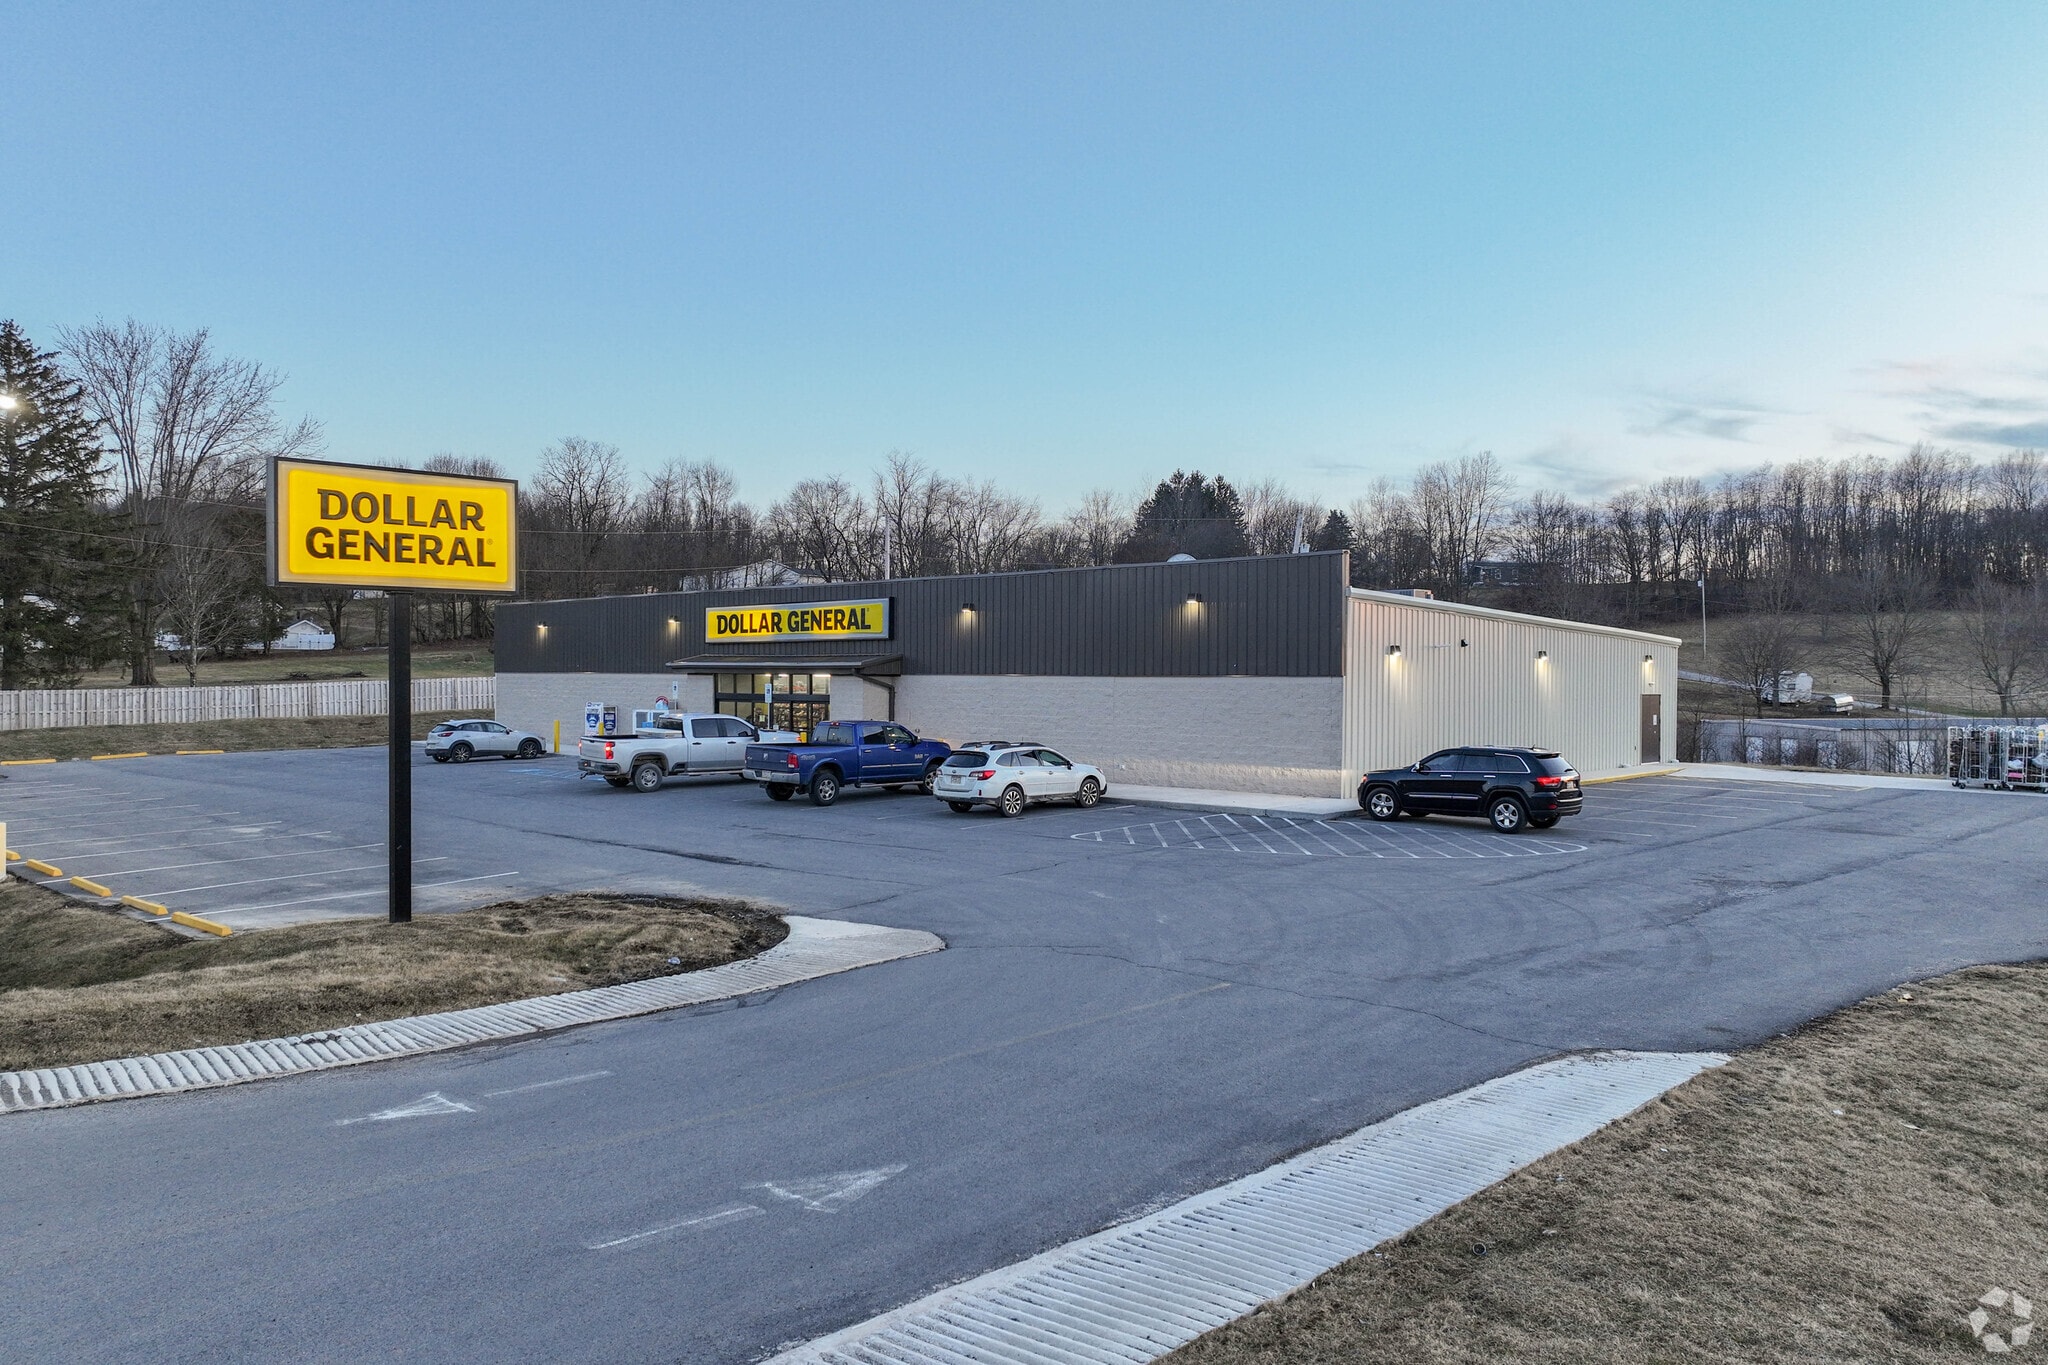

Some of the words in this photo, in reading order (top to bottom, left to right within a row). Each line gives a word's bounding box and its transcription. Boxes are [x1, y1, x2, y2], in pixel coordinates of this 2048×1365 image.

[317, 488, 486, 531] DOLLAR
[717, 612, 783, 635] DOLLAR
[787, 608, 871, 633] GENERAL
